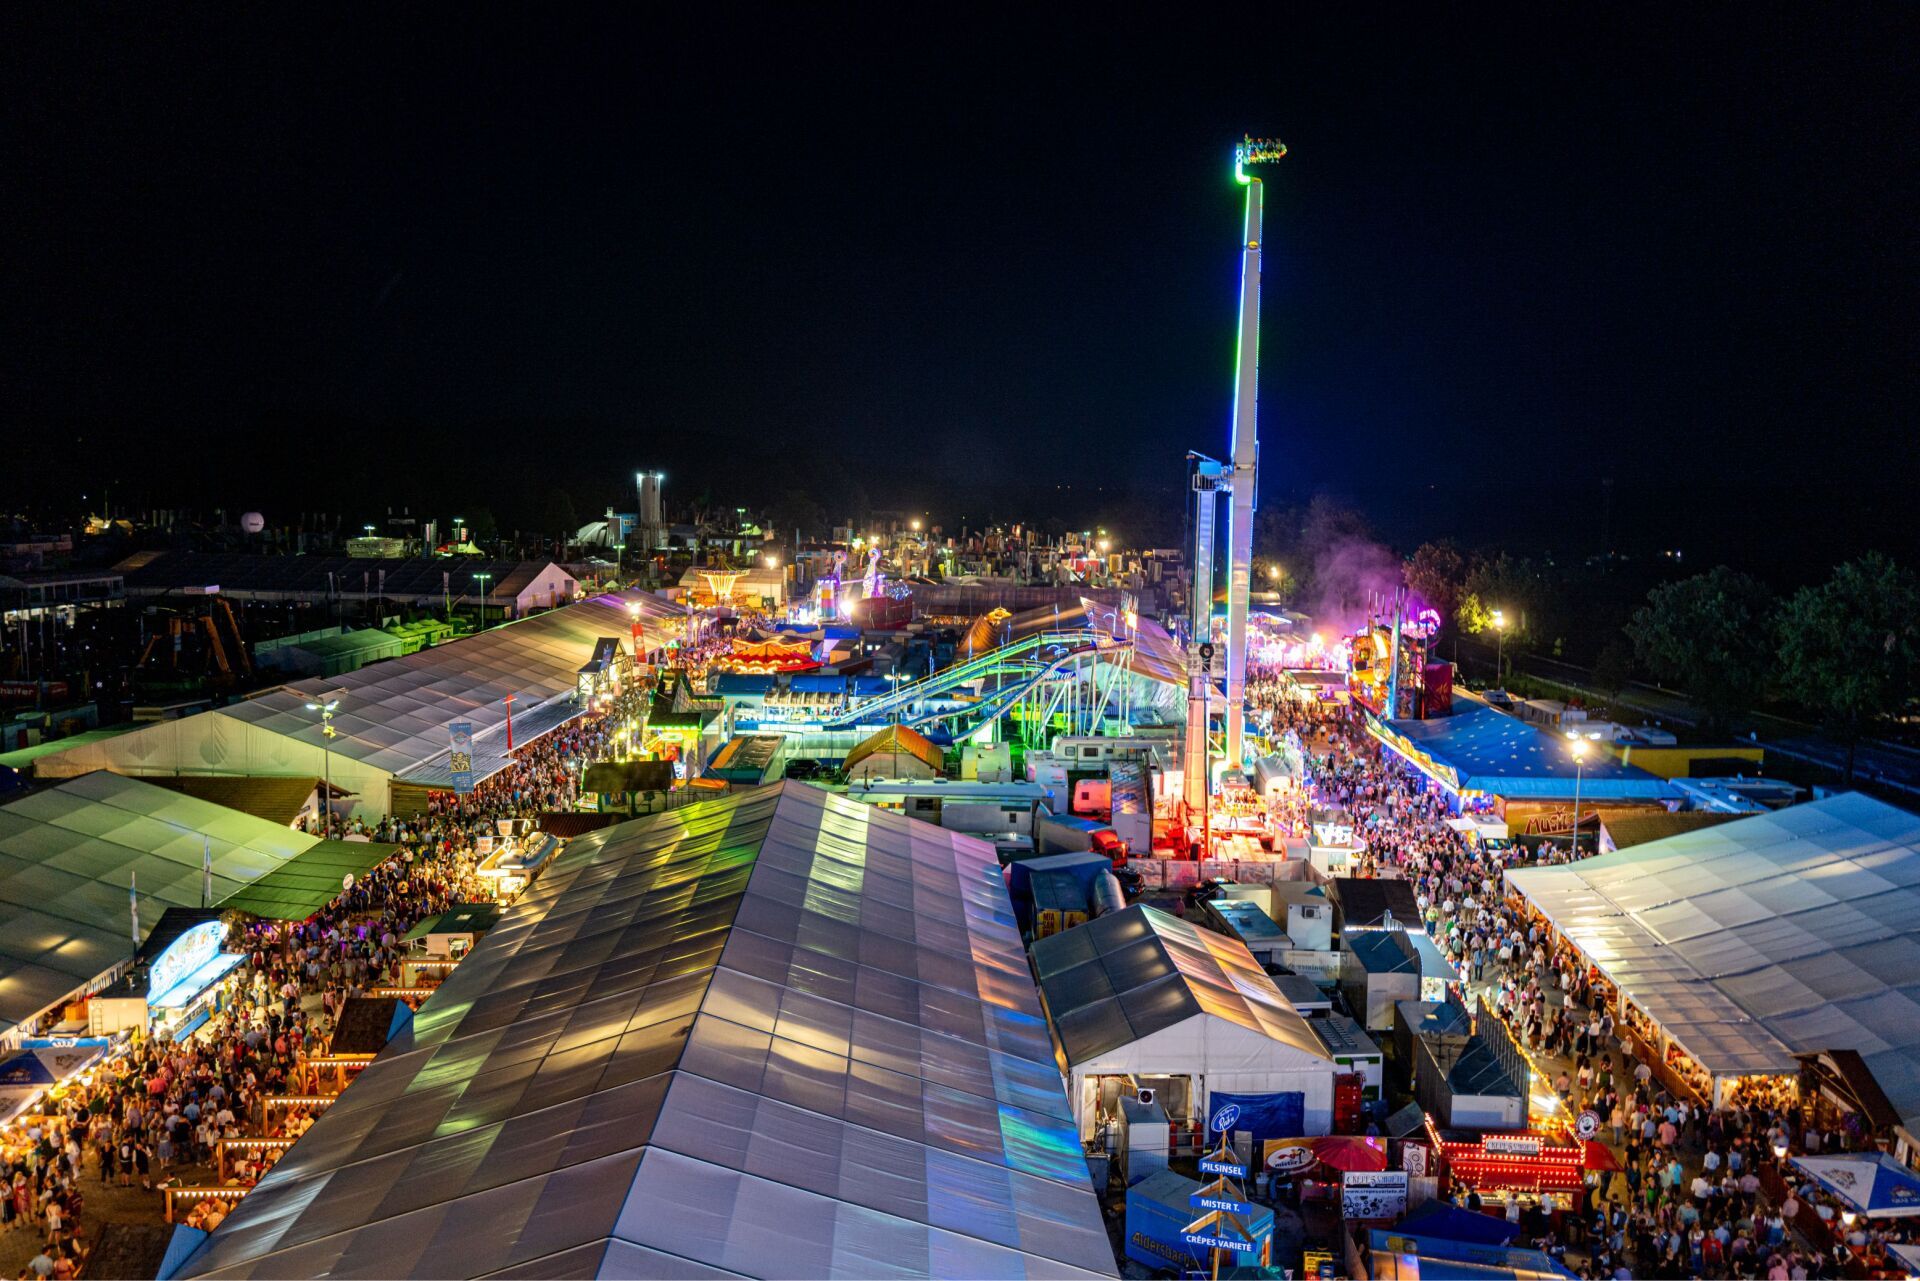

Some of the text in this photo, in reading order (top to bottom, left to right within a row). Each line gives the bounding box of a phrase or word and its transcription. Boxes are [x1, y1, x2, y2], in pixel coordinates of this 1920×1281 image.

[1202, 1162, 1243, 1176] PILSINSEL
[1201, 1199, 1240, 1212] MISTER T.
[1132, 1232, 1201, 1269] Aldersbache
[1186, 1234, 1252, 1252] CRÊPES VARIETÉ
